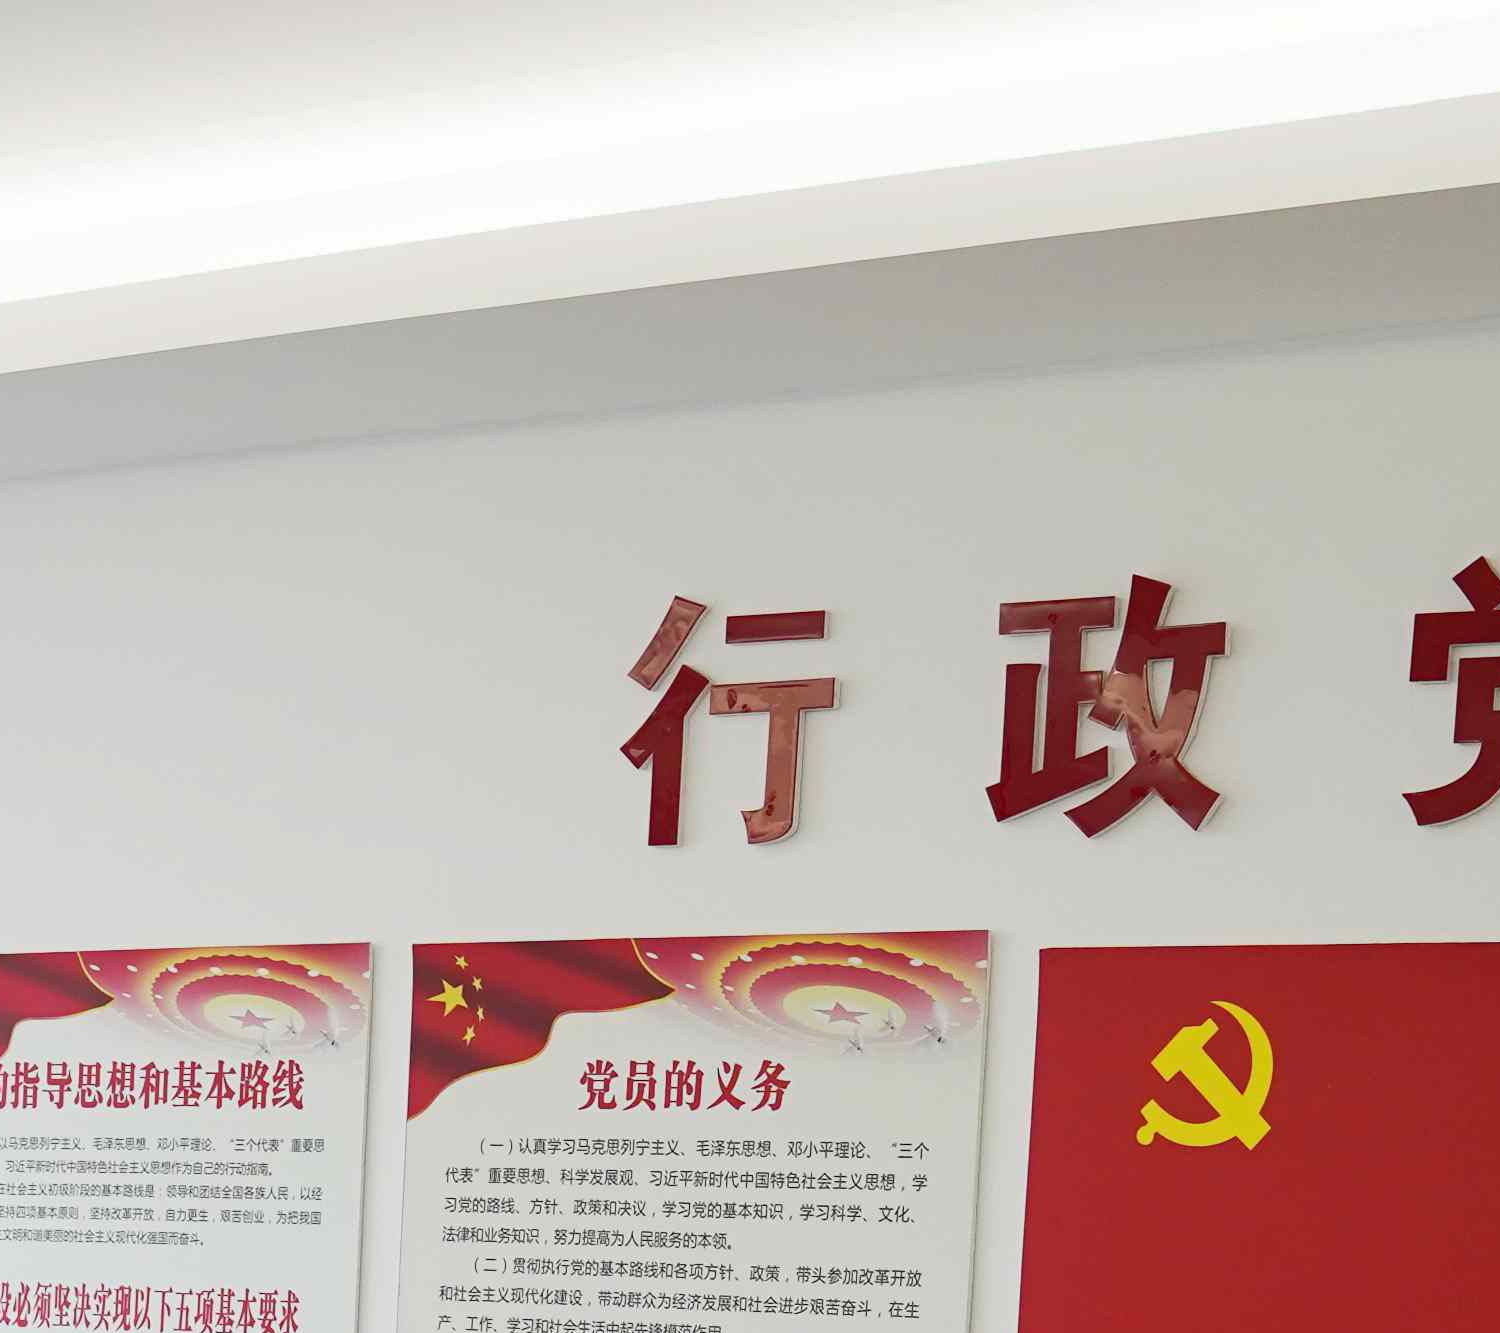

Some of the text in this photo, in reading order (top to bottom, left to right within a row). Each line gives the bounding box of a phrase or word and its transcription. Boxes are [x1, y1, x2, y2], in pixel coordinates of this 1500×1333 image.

[576, 1058, 792, 1112] 党员的义务
